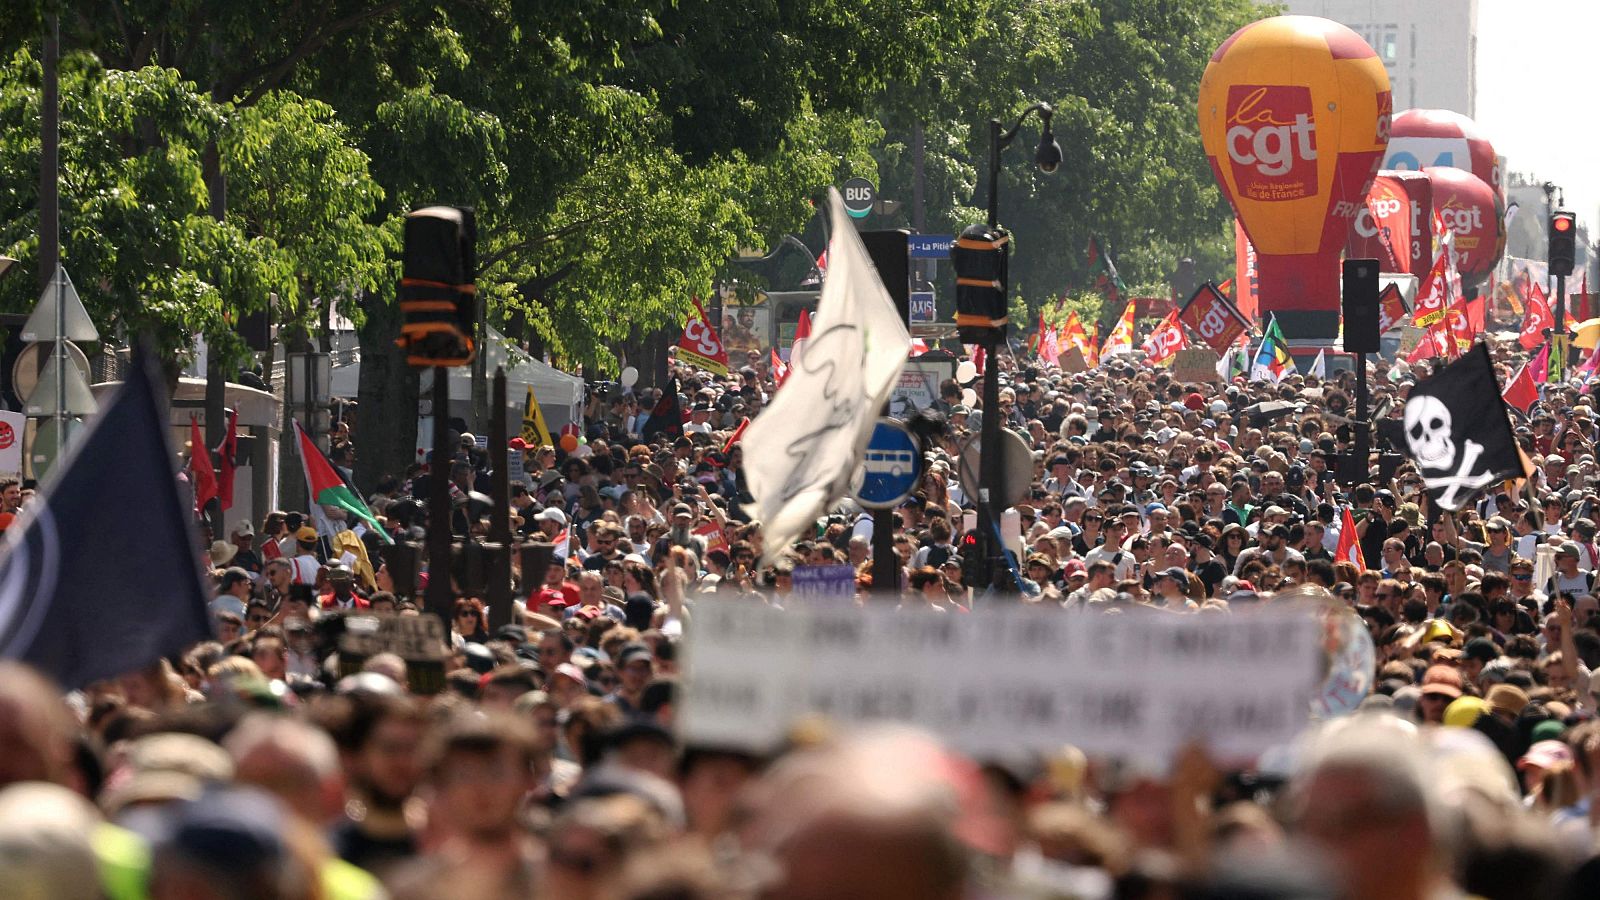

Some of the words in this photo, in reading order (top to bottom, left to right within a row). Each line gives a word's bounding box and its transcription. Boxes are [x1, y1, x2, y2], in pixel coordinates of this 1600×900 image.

[1226, 113, 1318, 176] cgt
[846, 187, 872, 201] BUS
[1354, 200, 1421, 247] ct
[1439, 205, 1483, 235] cgt
[922, 243, 931, 251] La
[933, 242, 950, 251] Pitié
[1411, 240, 1421, 260] 3
[911, 300, 932, 314] AXIS
[1200, 300, 1229, 338] cgt
